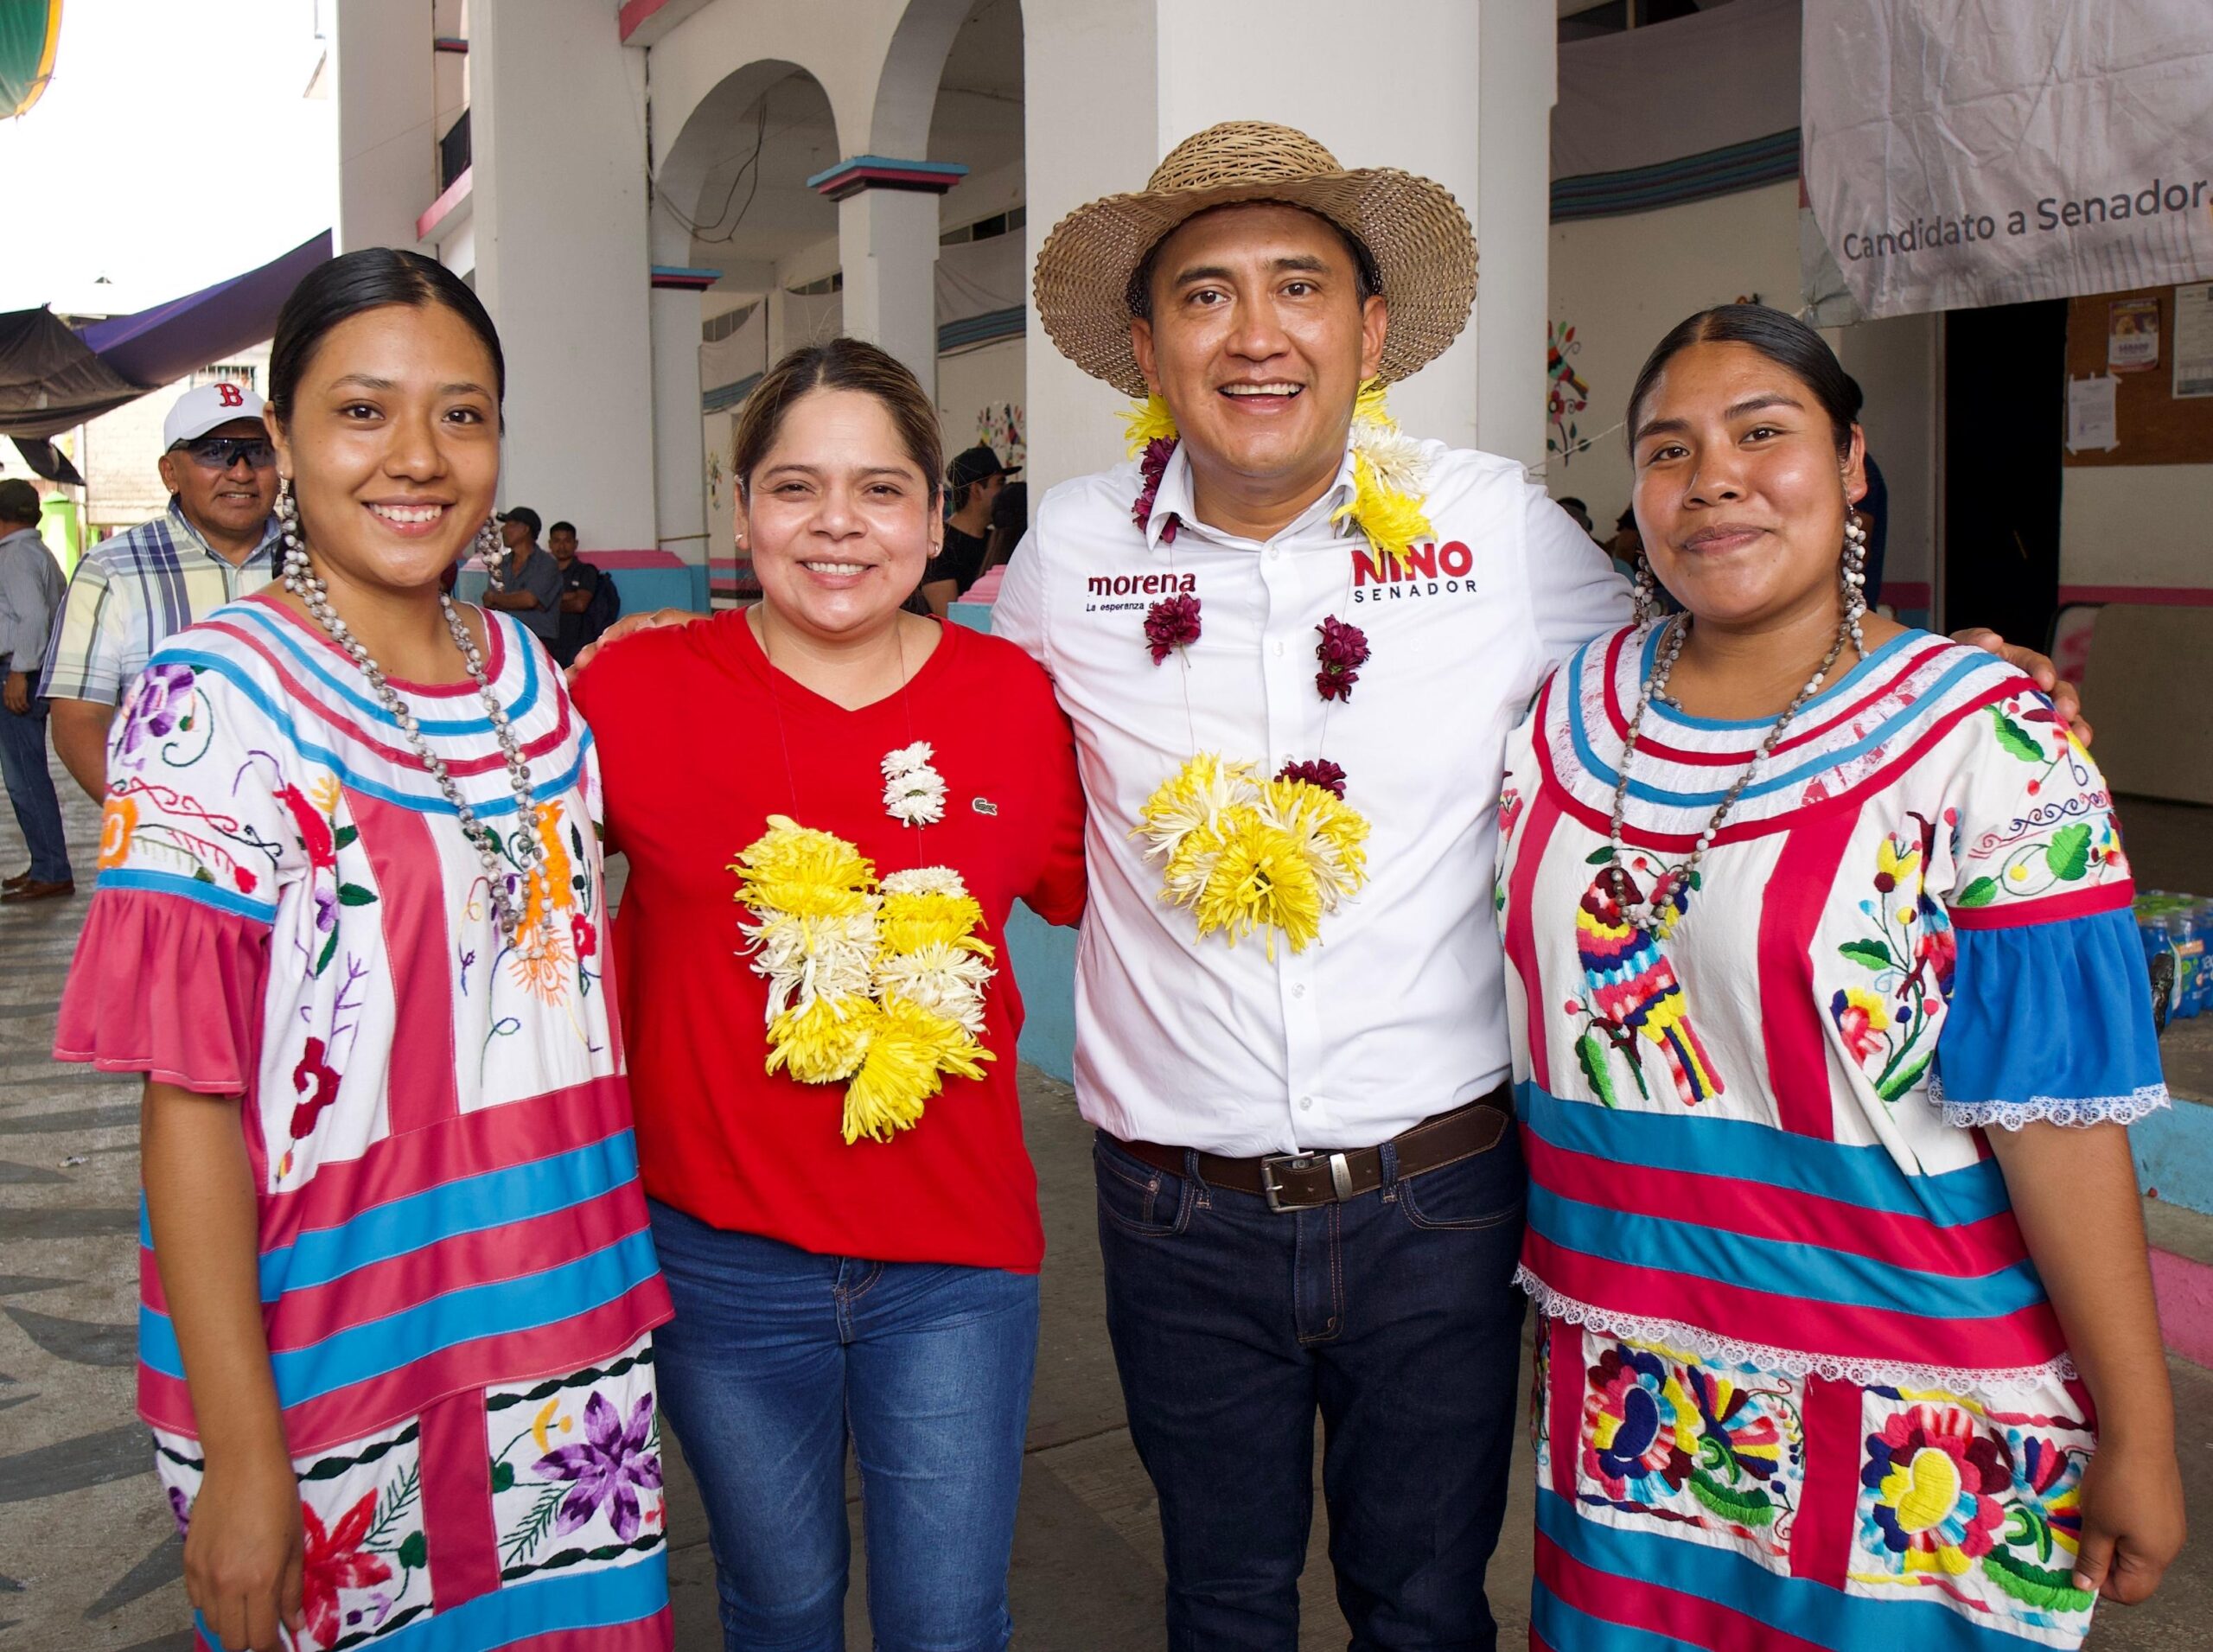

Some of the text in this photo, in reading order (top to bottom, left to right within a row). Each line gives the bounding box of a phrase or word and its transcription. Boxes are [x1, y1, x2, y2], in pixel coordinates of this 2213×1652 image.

[1843, 213, 1995, 261] Candidato
[2006, 209, 2026, 236] a
[214, 384, 244, 407] B
[1088, 573, 1196, 596] morena
[1355, 580, 1477, 603] SENADOR
[1087, 603, 1096, 612] La
[1100, 603, 1145, 613] esperanza
